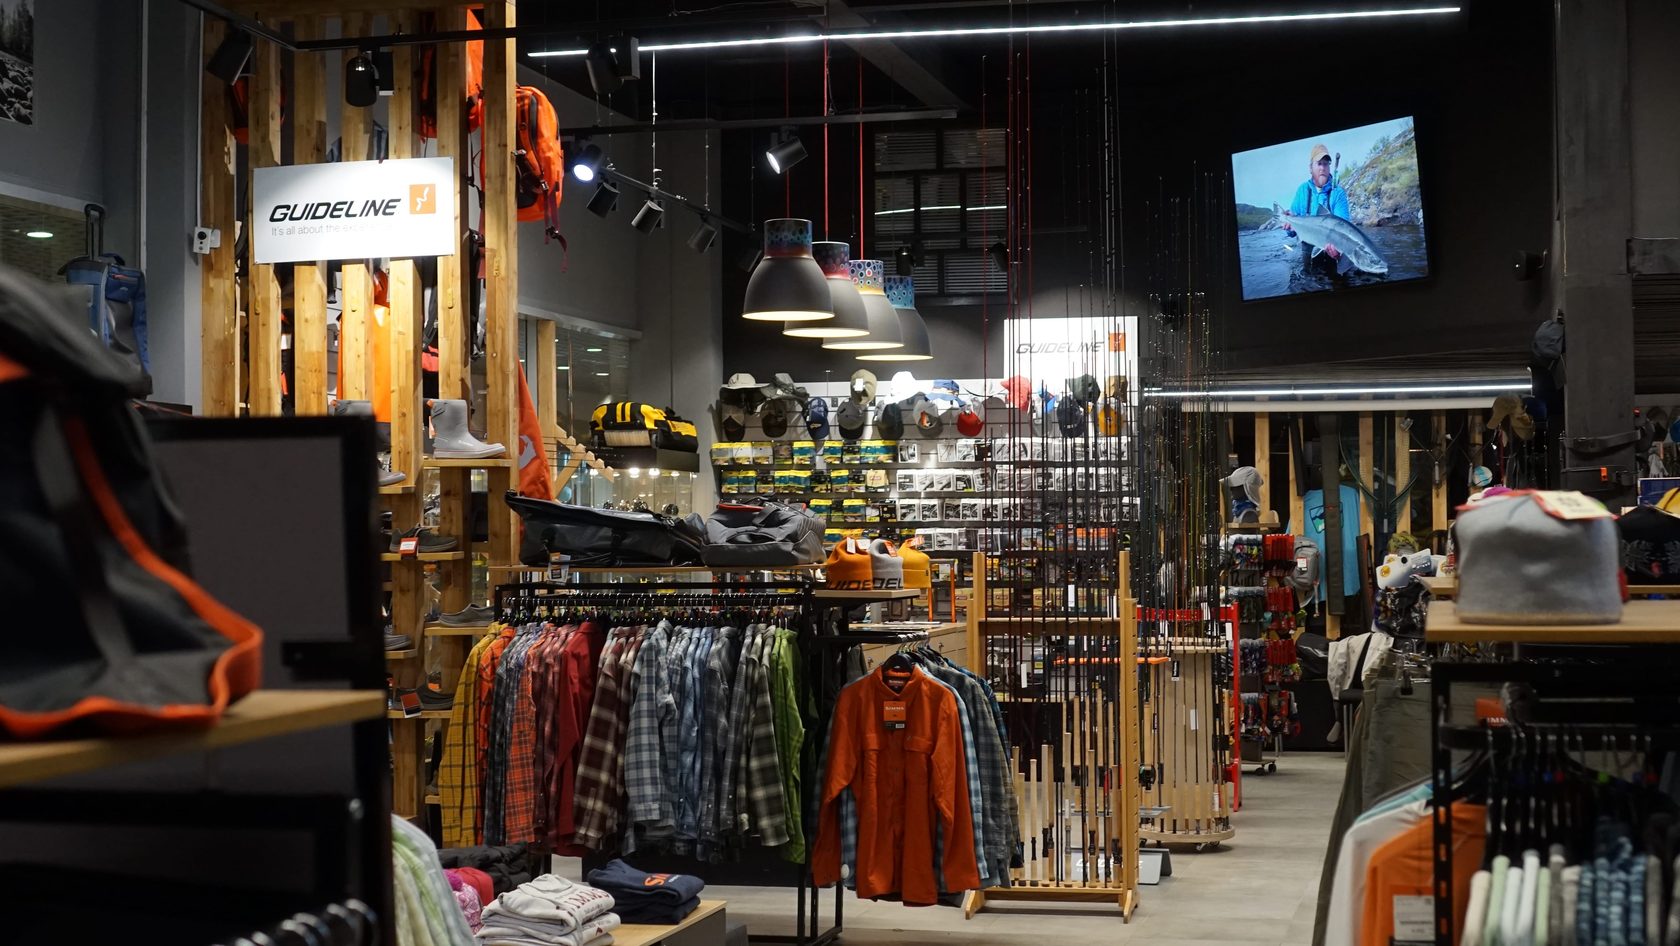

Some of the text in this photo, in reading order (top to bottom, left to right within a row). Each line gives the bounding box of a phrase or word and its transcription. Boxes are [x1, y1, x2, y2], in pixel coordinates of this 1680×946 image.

[269, 198, 401, 222] GUIDELINE
[271, 226, 284, 236] It's
[286, 225, 296, 235] all
[297, 224, 323, 235] about
[1016, 341, 1105, 354] GUIDELINE
